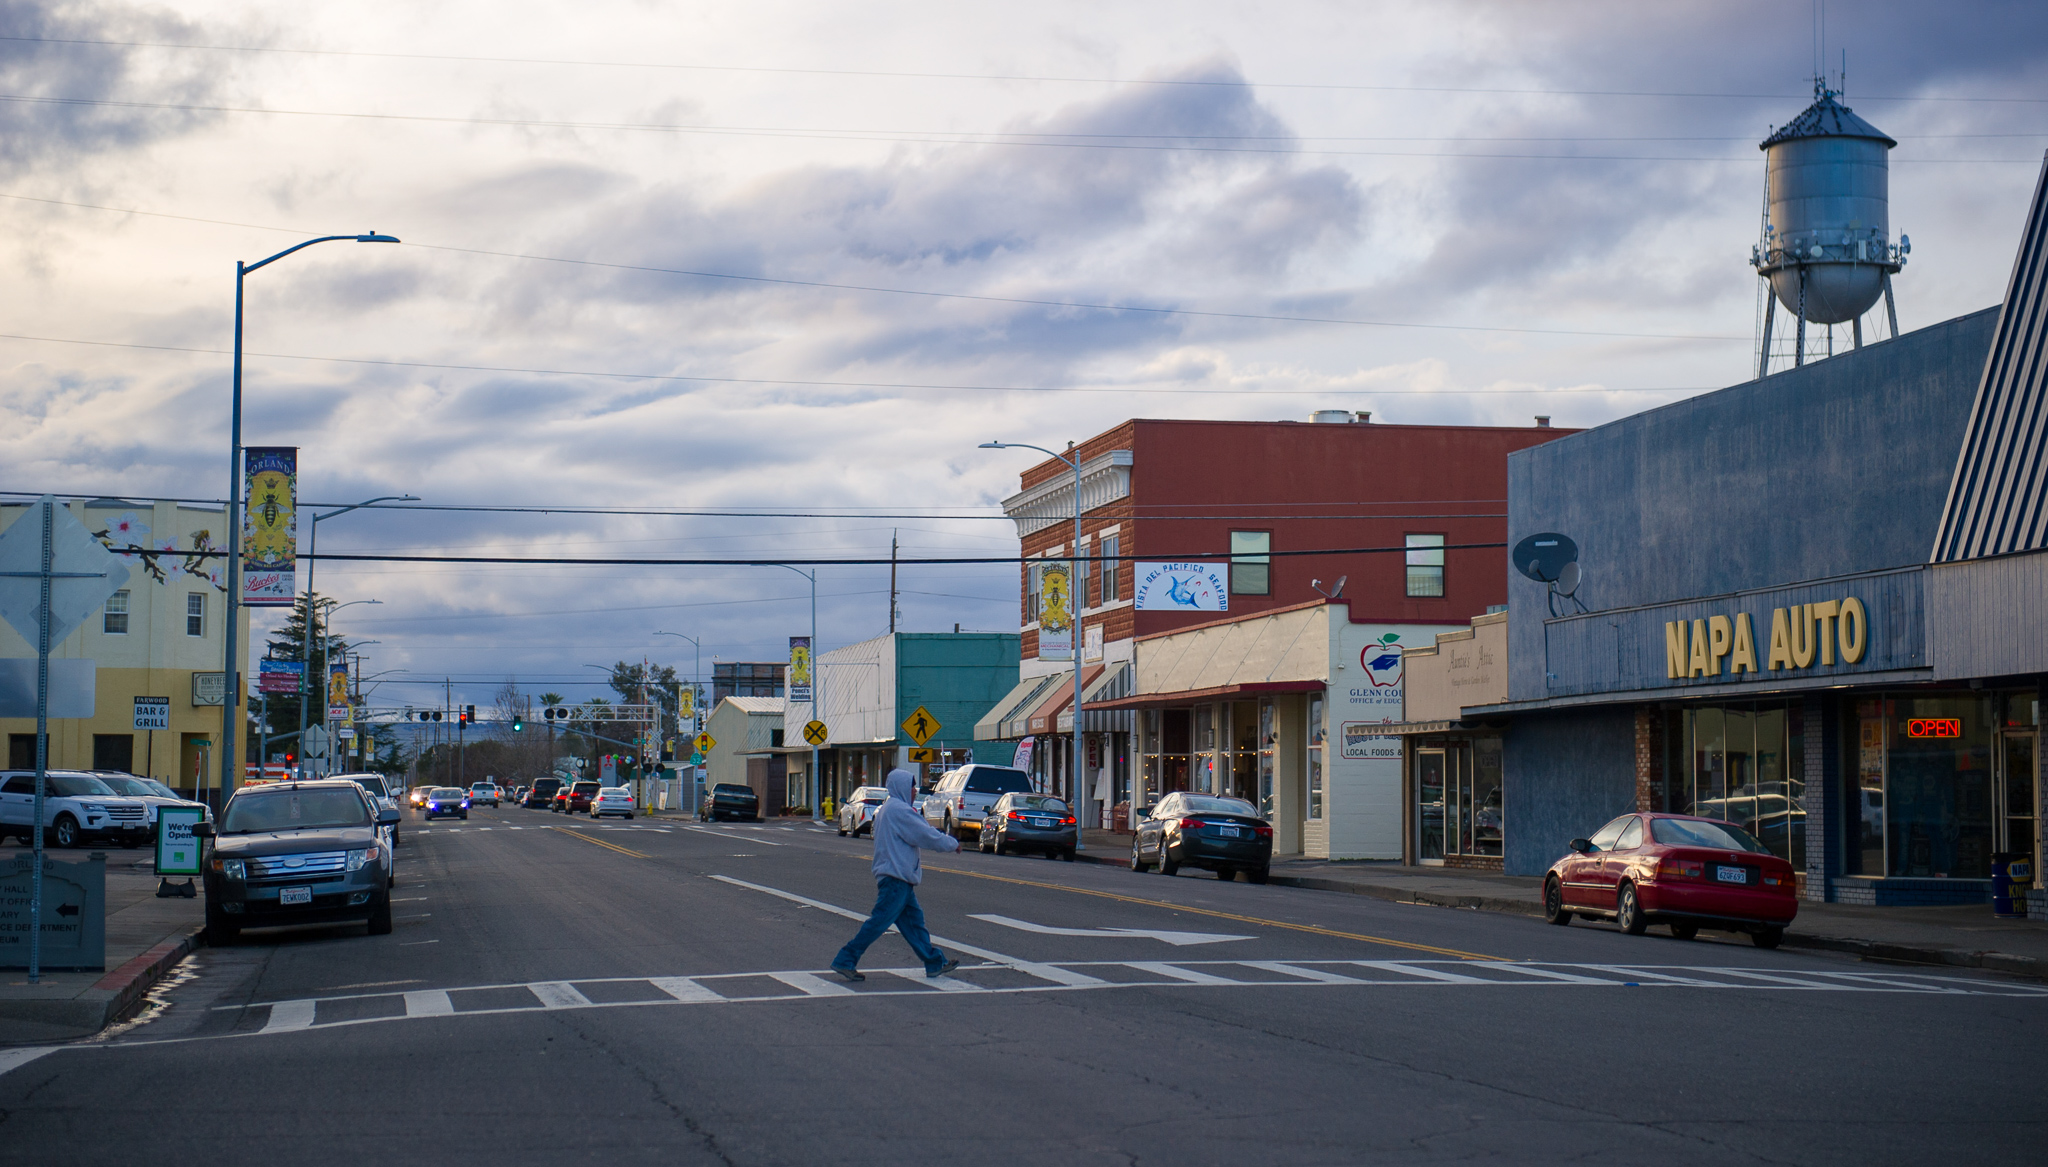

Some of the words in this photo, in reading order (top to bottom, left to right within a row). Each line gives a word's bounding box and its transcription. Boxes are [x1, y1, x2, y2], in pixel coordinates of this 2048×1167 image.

[251, 459, 290, 474] ORLAND
[1136, 585, 1149, 609] VISTA
[1146, 570, 1161, 583] DEL
[1162, 563, 1204, 573] PACIFICO
[1208, 573, 1227, 610] SEAFOOD
[1665, 612, 1758, 679] NAPA
[1768, 596, 1867, 671] AUTO
[1448, 649, 1470, 673] Auntie's
[1477, 645, 1493, 670] Attic
[1349, 688, 1382, 697] GLENN
[136, 706, 156, 716] BAR
[159, 706, 167, 716] &
[135, 718, 166, 728] GRILL
[1910, 720, 1958, 736] OPEN
[1089, 739, 1097, 768] OPEN
[1346, 748, 1368, 756] LOCAL
[1371, 748, 1395, 756] FOODS
[1397, 748, 1403, 756] &
[168, 823, 193, 831] We're
[9, 860, 54, 870] ORLND
[2012, 899, 2026, 913] HO
[0, 911, 19, 919] ARY
